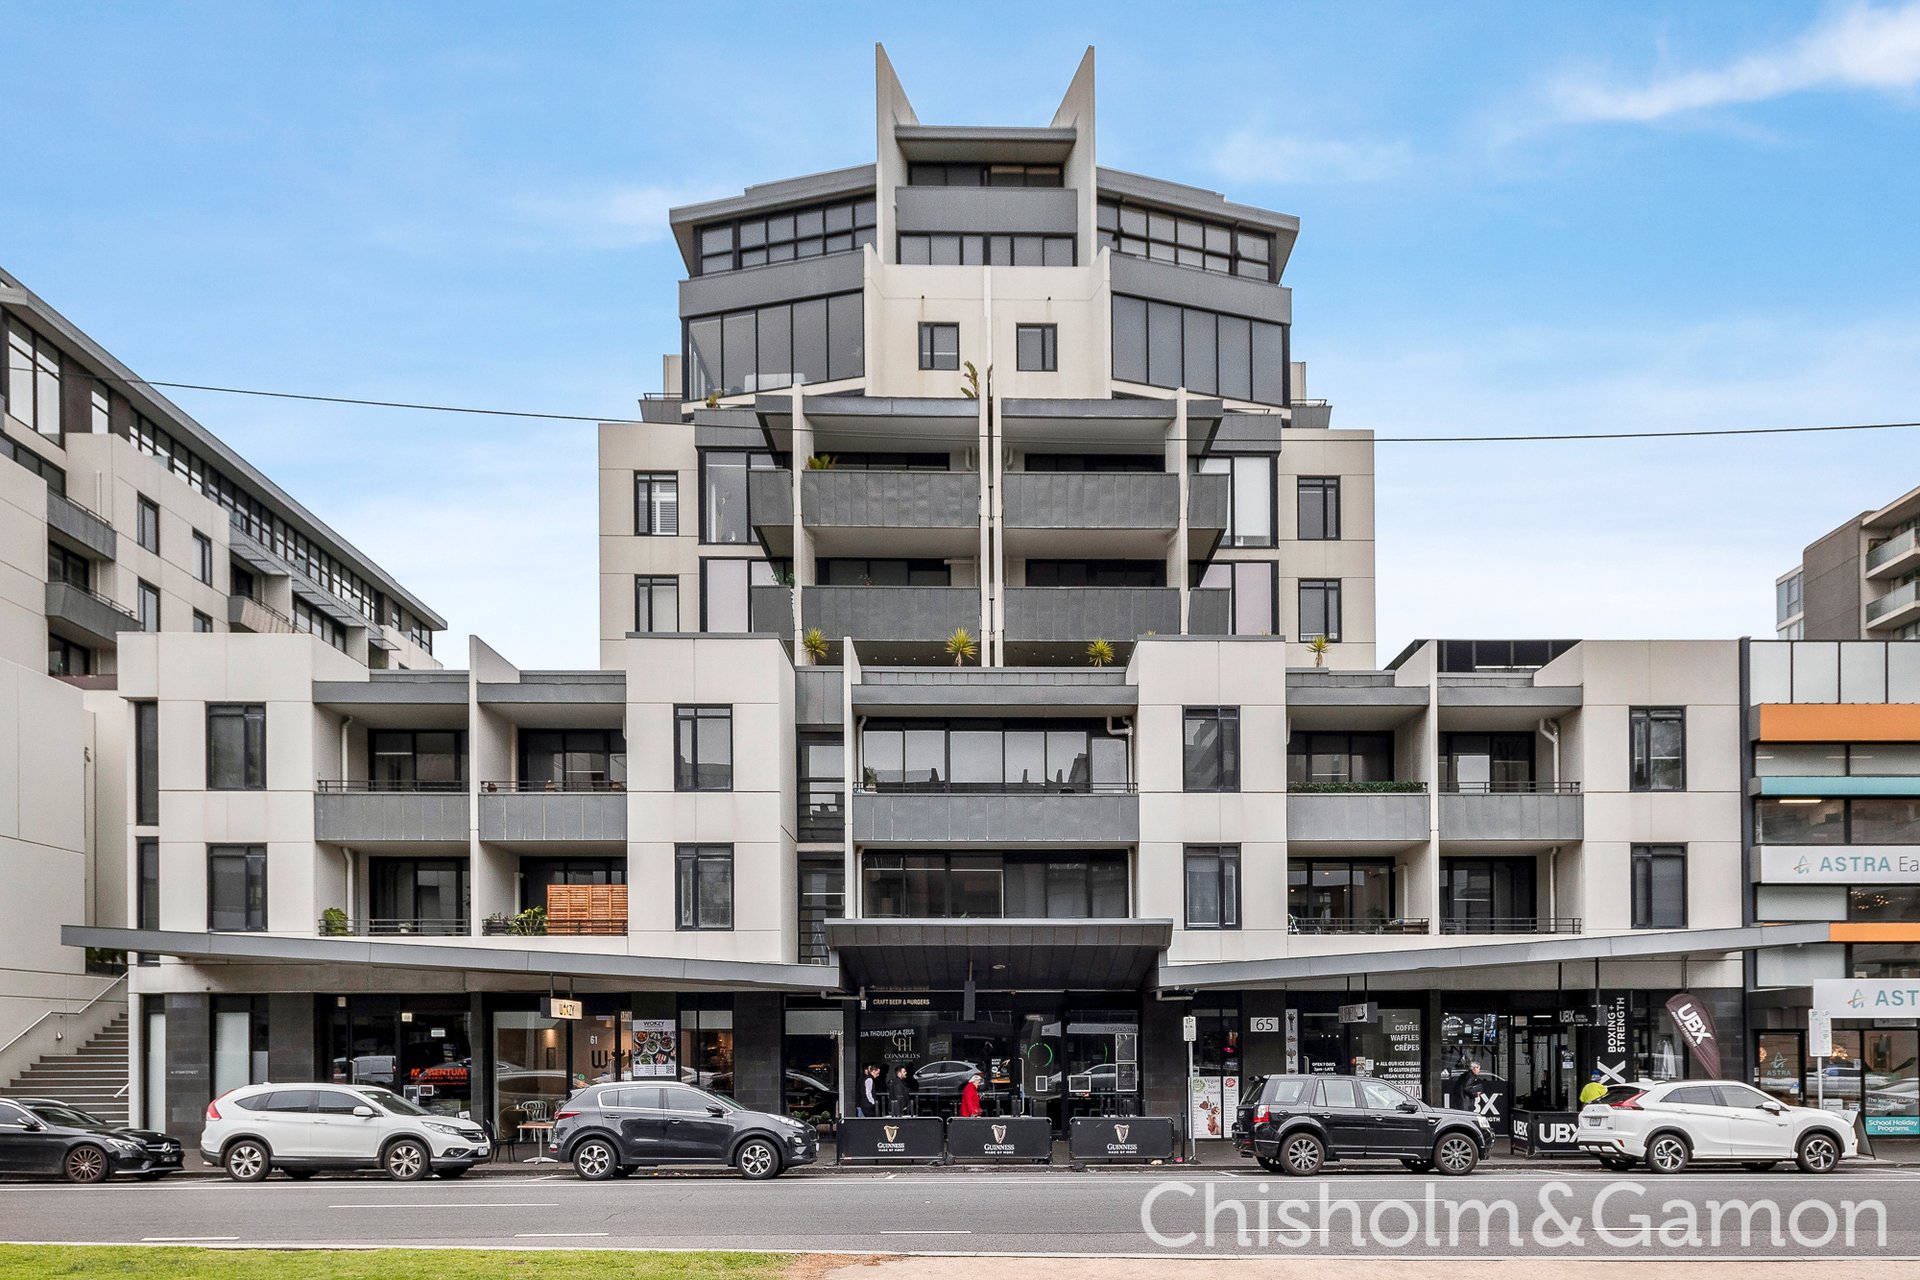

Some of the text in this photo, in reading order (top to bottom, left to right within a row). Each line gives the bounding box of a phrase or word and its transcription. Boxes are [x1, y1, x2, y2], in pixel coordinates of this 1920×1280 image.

[1819, 856, 1919, 872] ASTRA Ea
[1875, 990, 1920, 1006] AST
[1560, 1010, 1575, 1022] UBX
[1256, 1019, 1273, 1030] 65
[1617, 997, 1625, 1053] STRENGTH
[1677, 1003, 1712, 1044] UBX
[1608, 1012, 1616, 1053] BOXING
[590, 1036, 598, 1045] 61
[1394, 1043, 1419, 1051] CRÊPES
[411, 1068, 467, 1076] MMENTUM
[1767, 1069, 1792, 1077] ASTRA
[1513, 1120, 1528, 1137] UBX
[1892, 1119, 1917, 1127] Holiday
[984, 1143, 1015, 1151] GUINNESS
